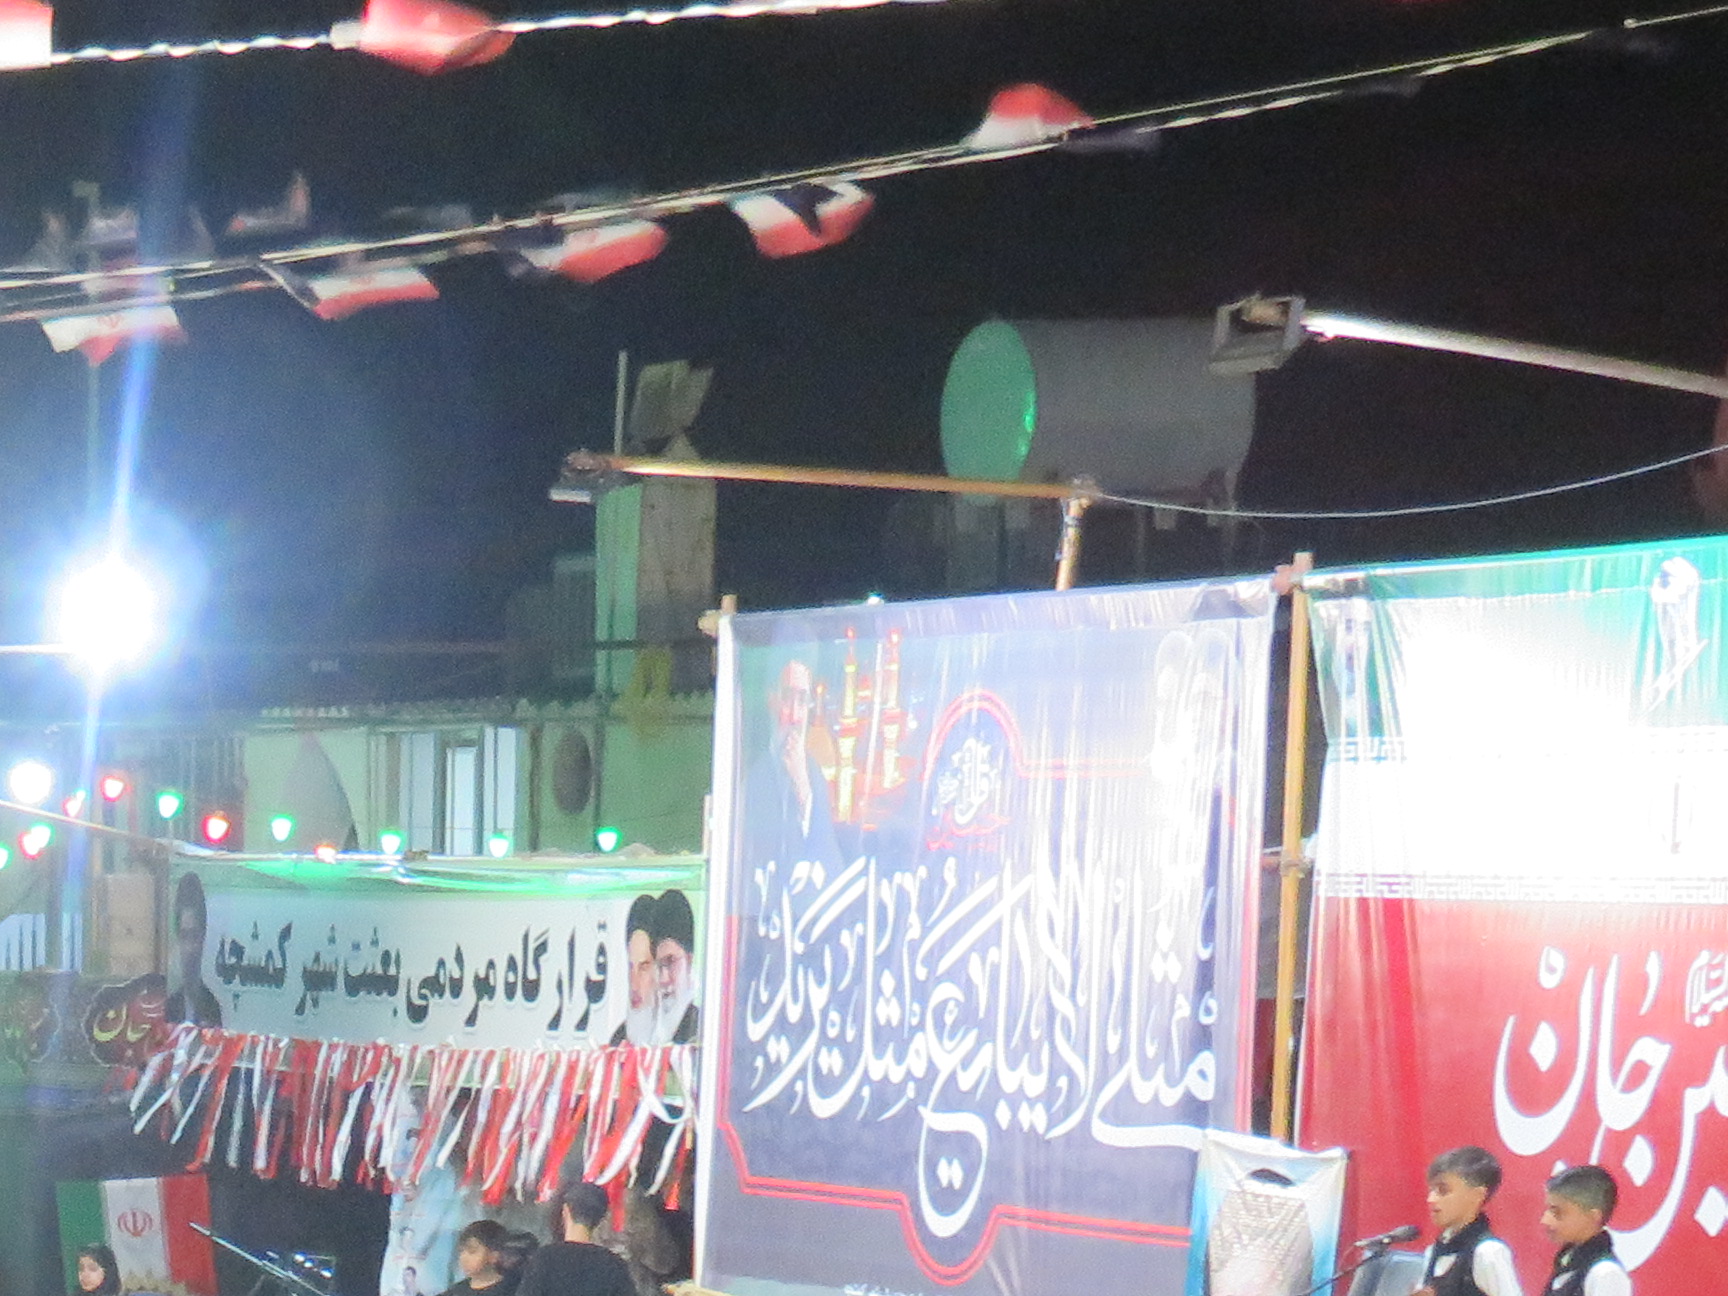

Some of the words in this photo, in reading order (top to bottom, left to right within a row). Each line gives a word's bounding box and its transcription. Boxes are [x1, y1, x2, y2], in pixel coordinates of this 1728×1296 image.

[215, 919, 293, 1011] کمشچه
[294, 924, 340, 1016] شهر
[344, 926, 402, 1017] بعثت
[404, 941, 499, 1028] مردمی
[503, 918, 610, 1033] قرارگاه
